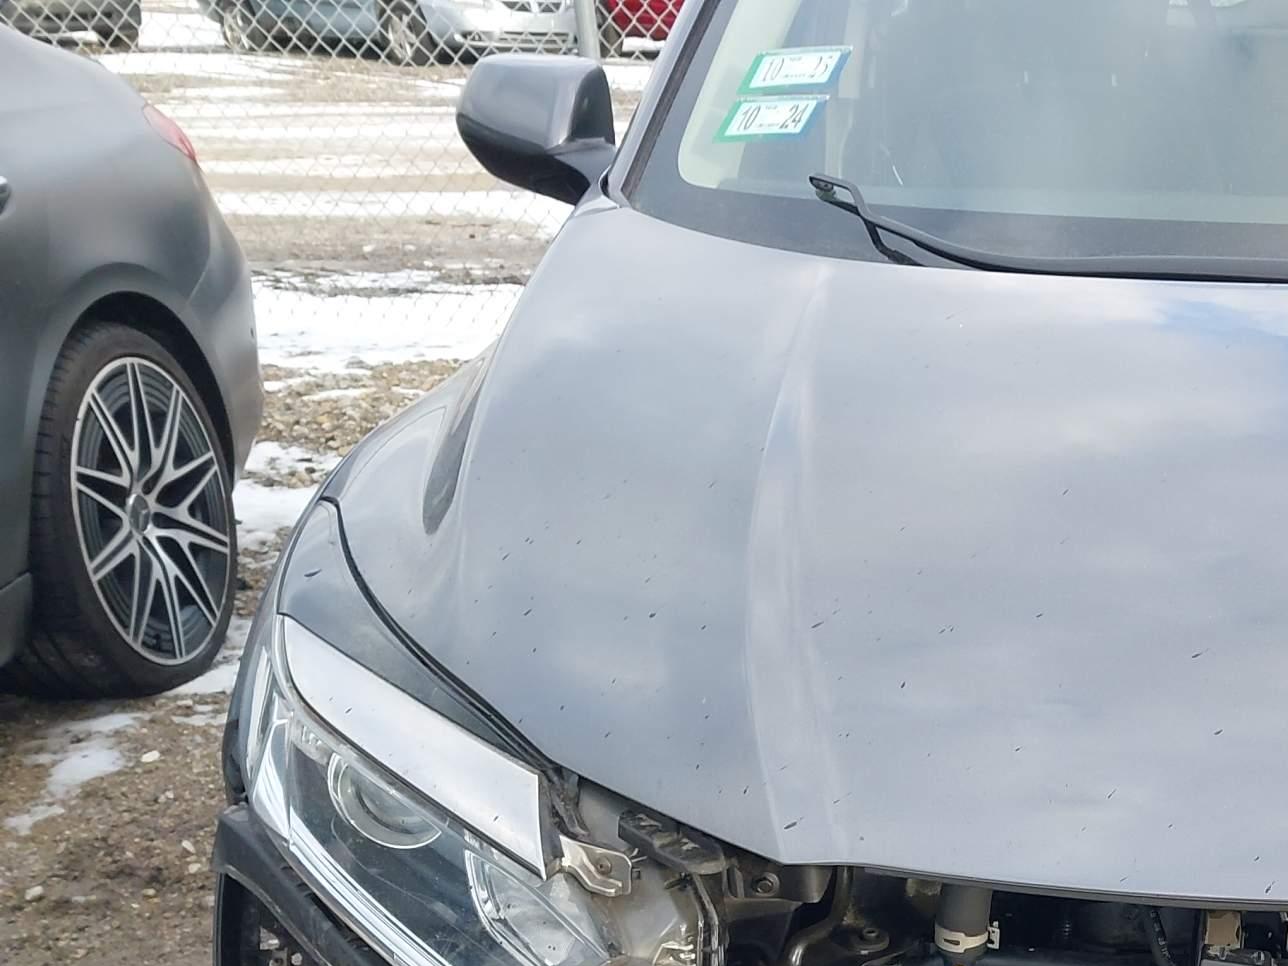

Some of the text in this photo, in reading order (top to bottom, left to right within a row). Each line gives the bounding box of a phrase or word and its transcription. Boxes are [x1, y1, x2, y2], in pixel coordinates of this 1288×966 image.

[762, 57, 785, 82] 10
[737, 103, 809, 132] 10 24
